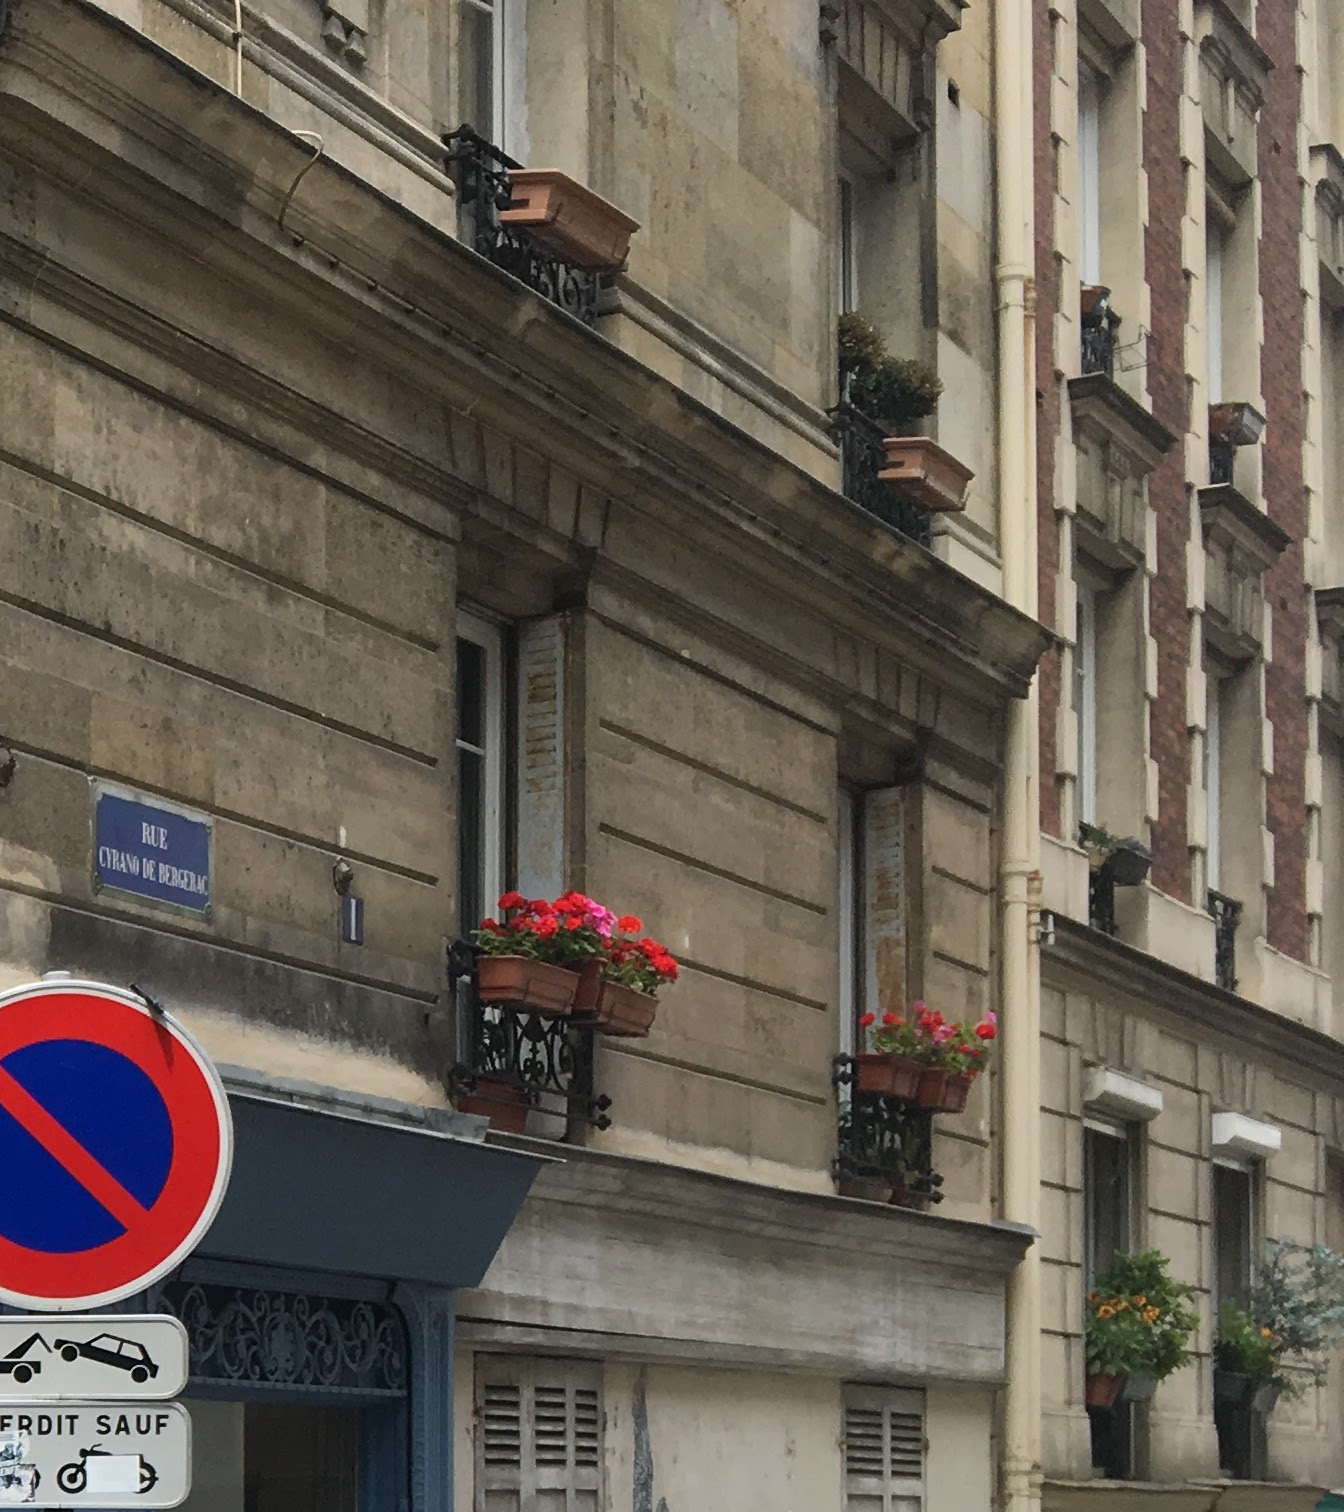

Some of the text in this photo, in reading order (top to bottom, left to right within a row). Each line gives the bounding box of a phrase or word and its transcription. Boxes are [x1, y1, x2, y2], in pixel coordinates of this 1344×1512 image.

[141, 821, 168, 850] RUE
[98, 846, 209, 896] CYRANO DE BERGERAC
[95, 1414, 170, 1436] SAUF
